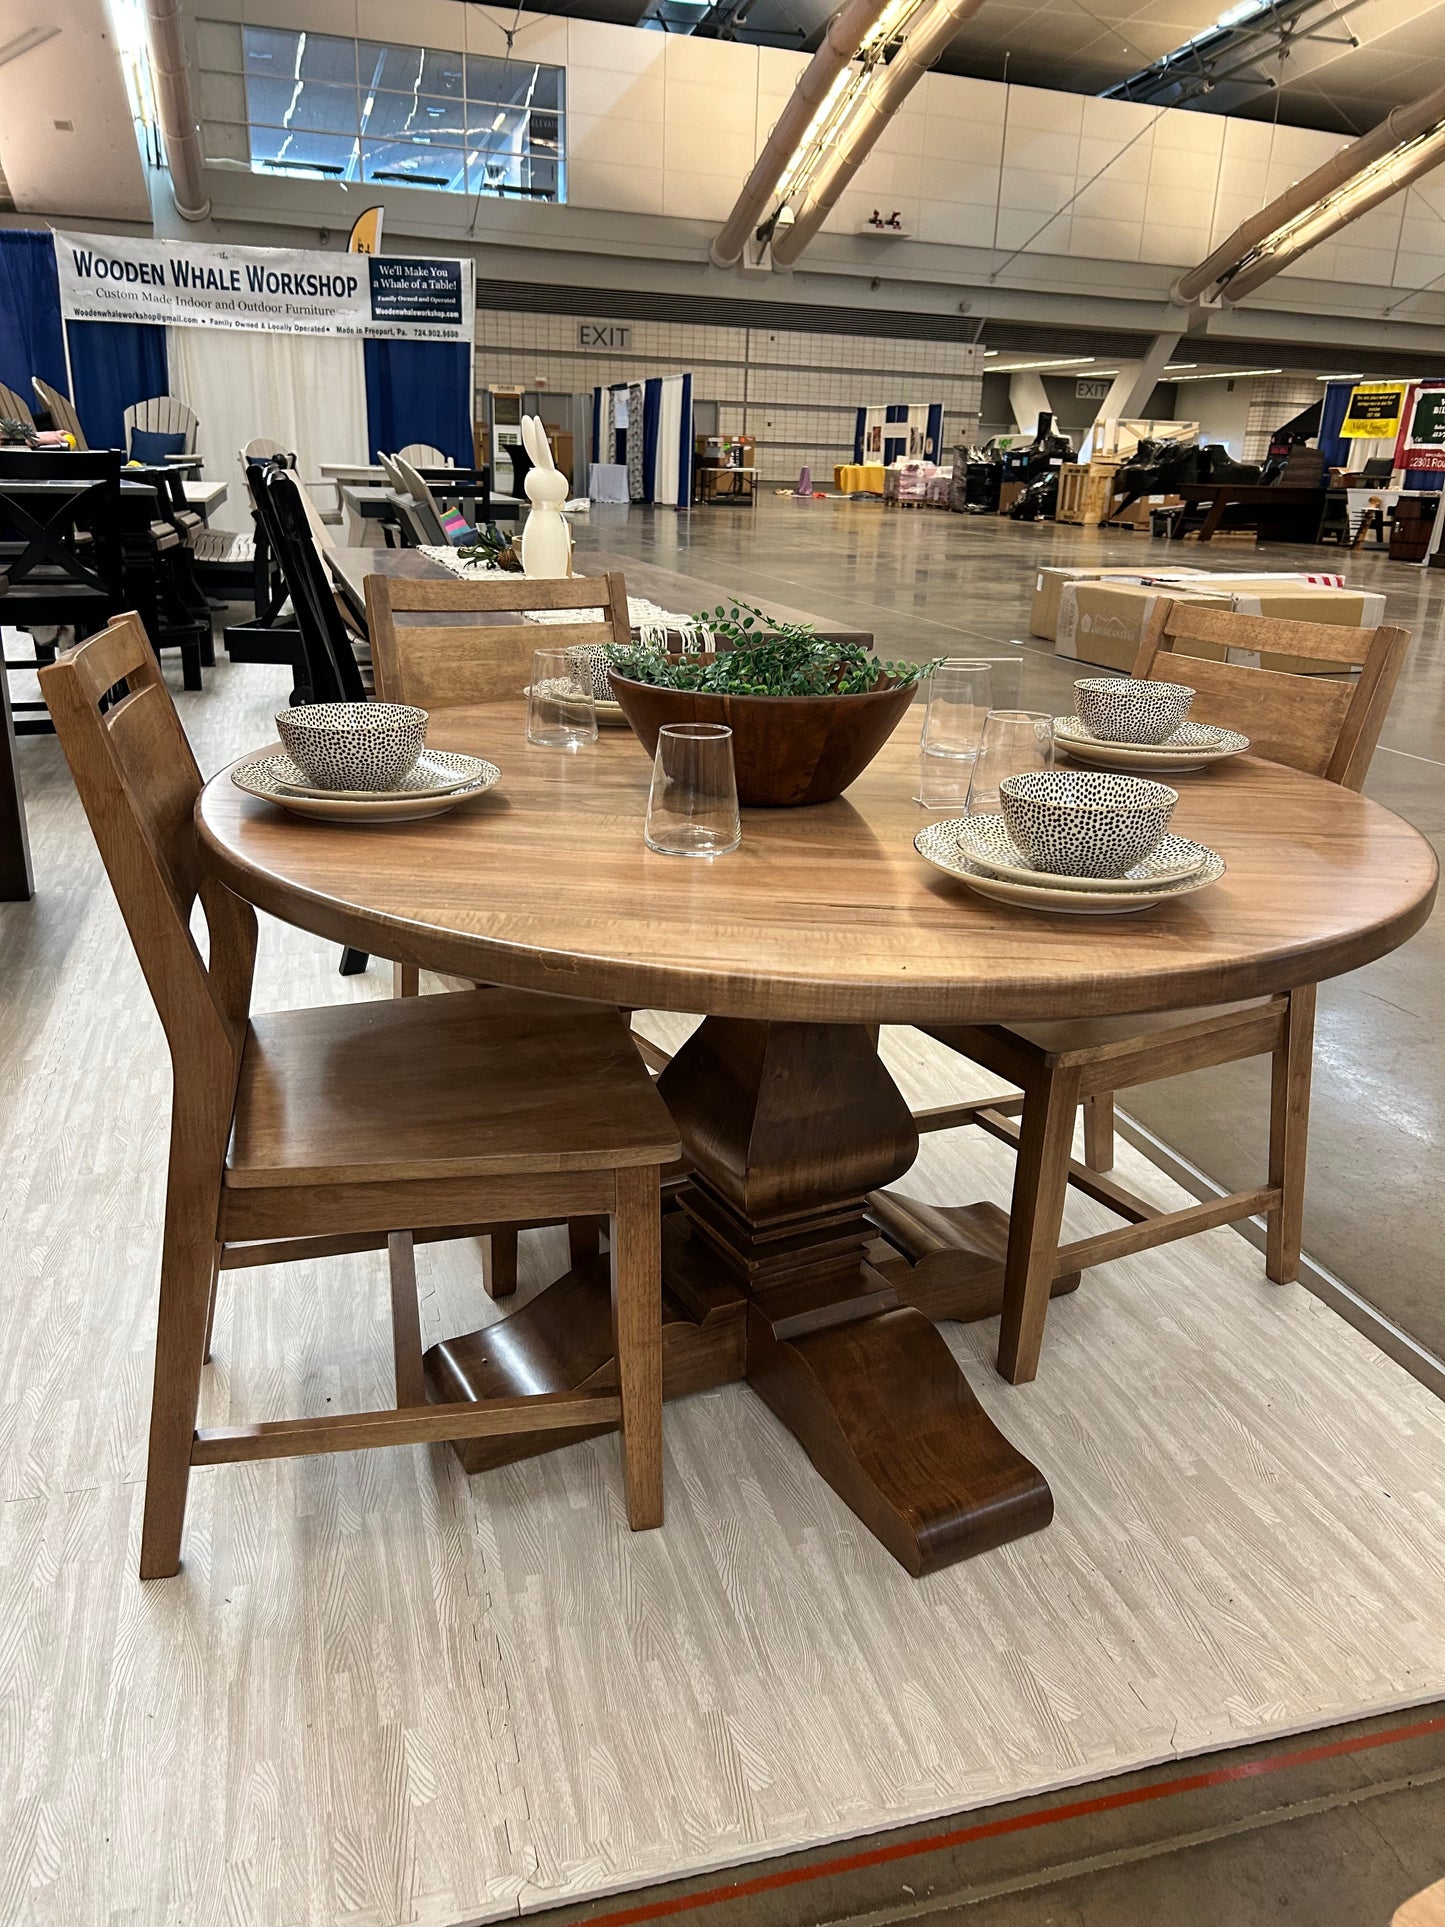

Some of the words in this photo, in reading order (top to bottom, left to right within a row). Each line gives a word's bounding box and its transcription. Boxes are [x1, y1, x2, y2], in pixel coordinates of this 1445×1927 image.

[72, 249, 166, 286] WOODEN
[169, 259, 241, 292] WHALE
[245, 264, 357, 298] WORKSHOP
[379, 265, 402, 276] We'll
[404, 266, 429, 276] Make
[430, 267, 448, 277] You
[373, 280, 379, 288] a
[380, 278, 409, 289] Whale
[411, 279, 420, 289] of
[428, 279, 457, 290] Table!
[95, 287, 138, 301] Custom
[142, 291, 172, 305] Made
[176, 295, 213, 308] Indoor
[215, 299, 235, 311] and
[238, 301, 283, 313] Outdoor
[285, 303, 336, 316] Furniture
[377, 295, 397, 303] Family
[375, 307, 460, 319] Woodenwhaleworkshop.com
[73, 307, 199, 324] Woodenwhaleworkshop@gmail.com
[210, 318, 233, 328] Family
[235, 320, 259, 329] Owned
[267, 322, 292, 332] Locally
[294, 324, 325, 333] Operated
[336, 326, 354, 334] Made
[364, 327, 395, 337] Freeport,
[396, 328, 408, 337] Pa.
[580, 325, 629, 347] EXIT
[1078, 382, 1107, 397] EXIT
